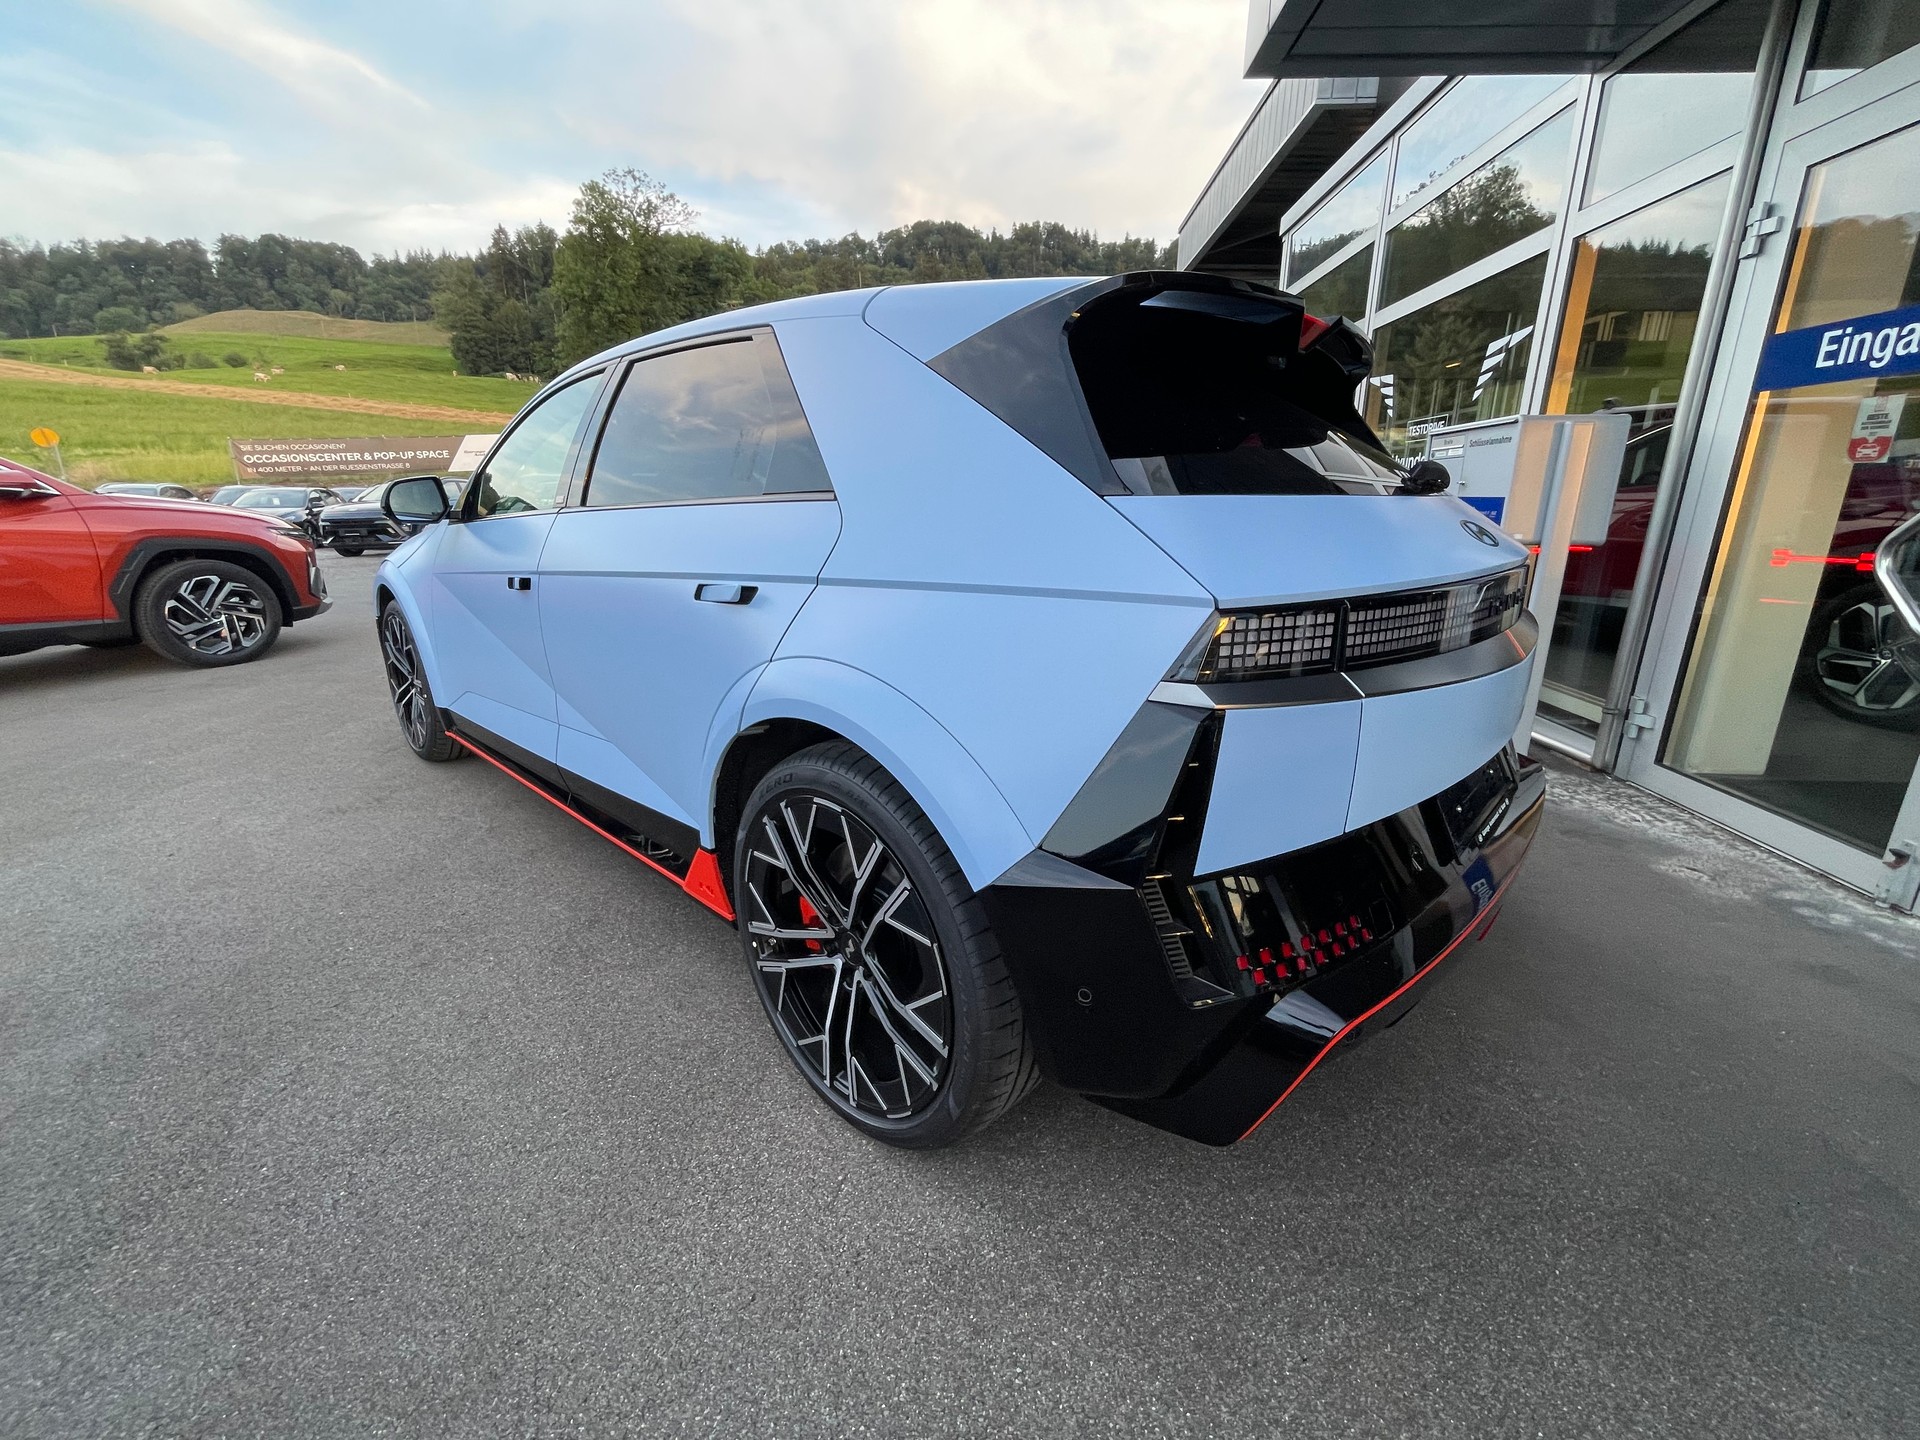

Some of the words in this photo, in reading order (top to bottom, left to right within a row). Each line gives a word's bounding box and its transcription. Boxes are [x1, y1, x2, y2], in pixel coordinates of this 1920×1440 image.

[240, 444, 254, 452] SIE
[290, 443, 346, 451] OCCASIONEN?
[243, 452, 362, 464] OCCASIONSCENTER
[363, 452, 373, 461] &
[373, 451, 415, 460] POP-UP
[416, 450, 450, 459] SPACE
[274, 465, 303, 473] METER
